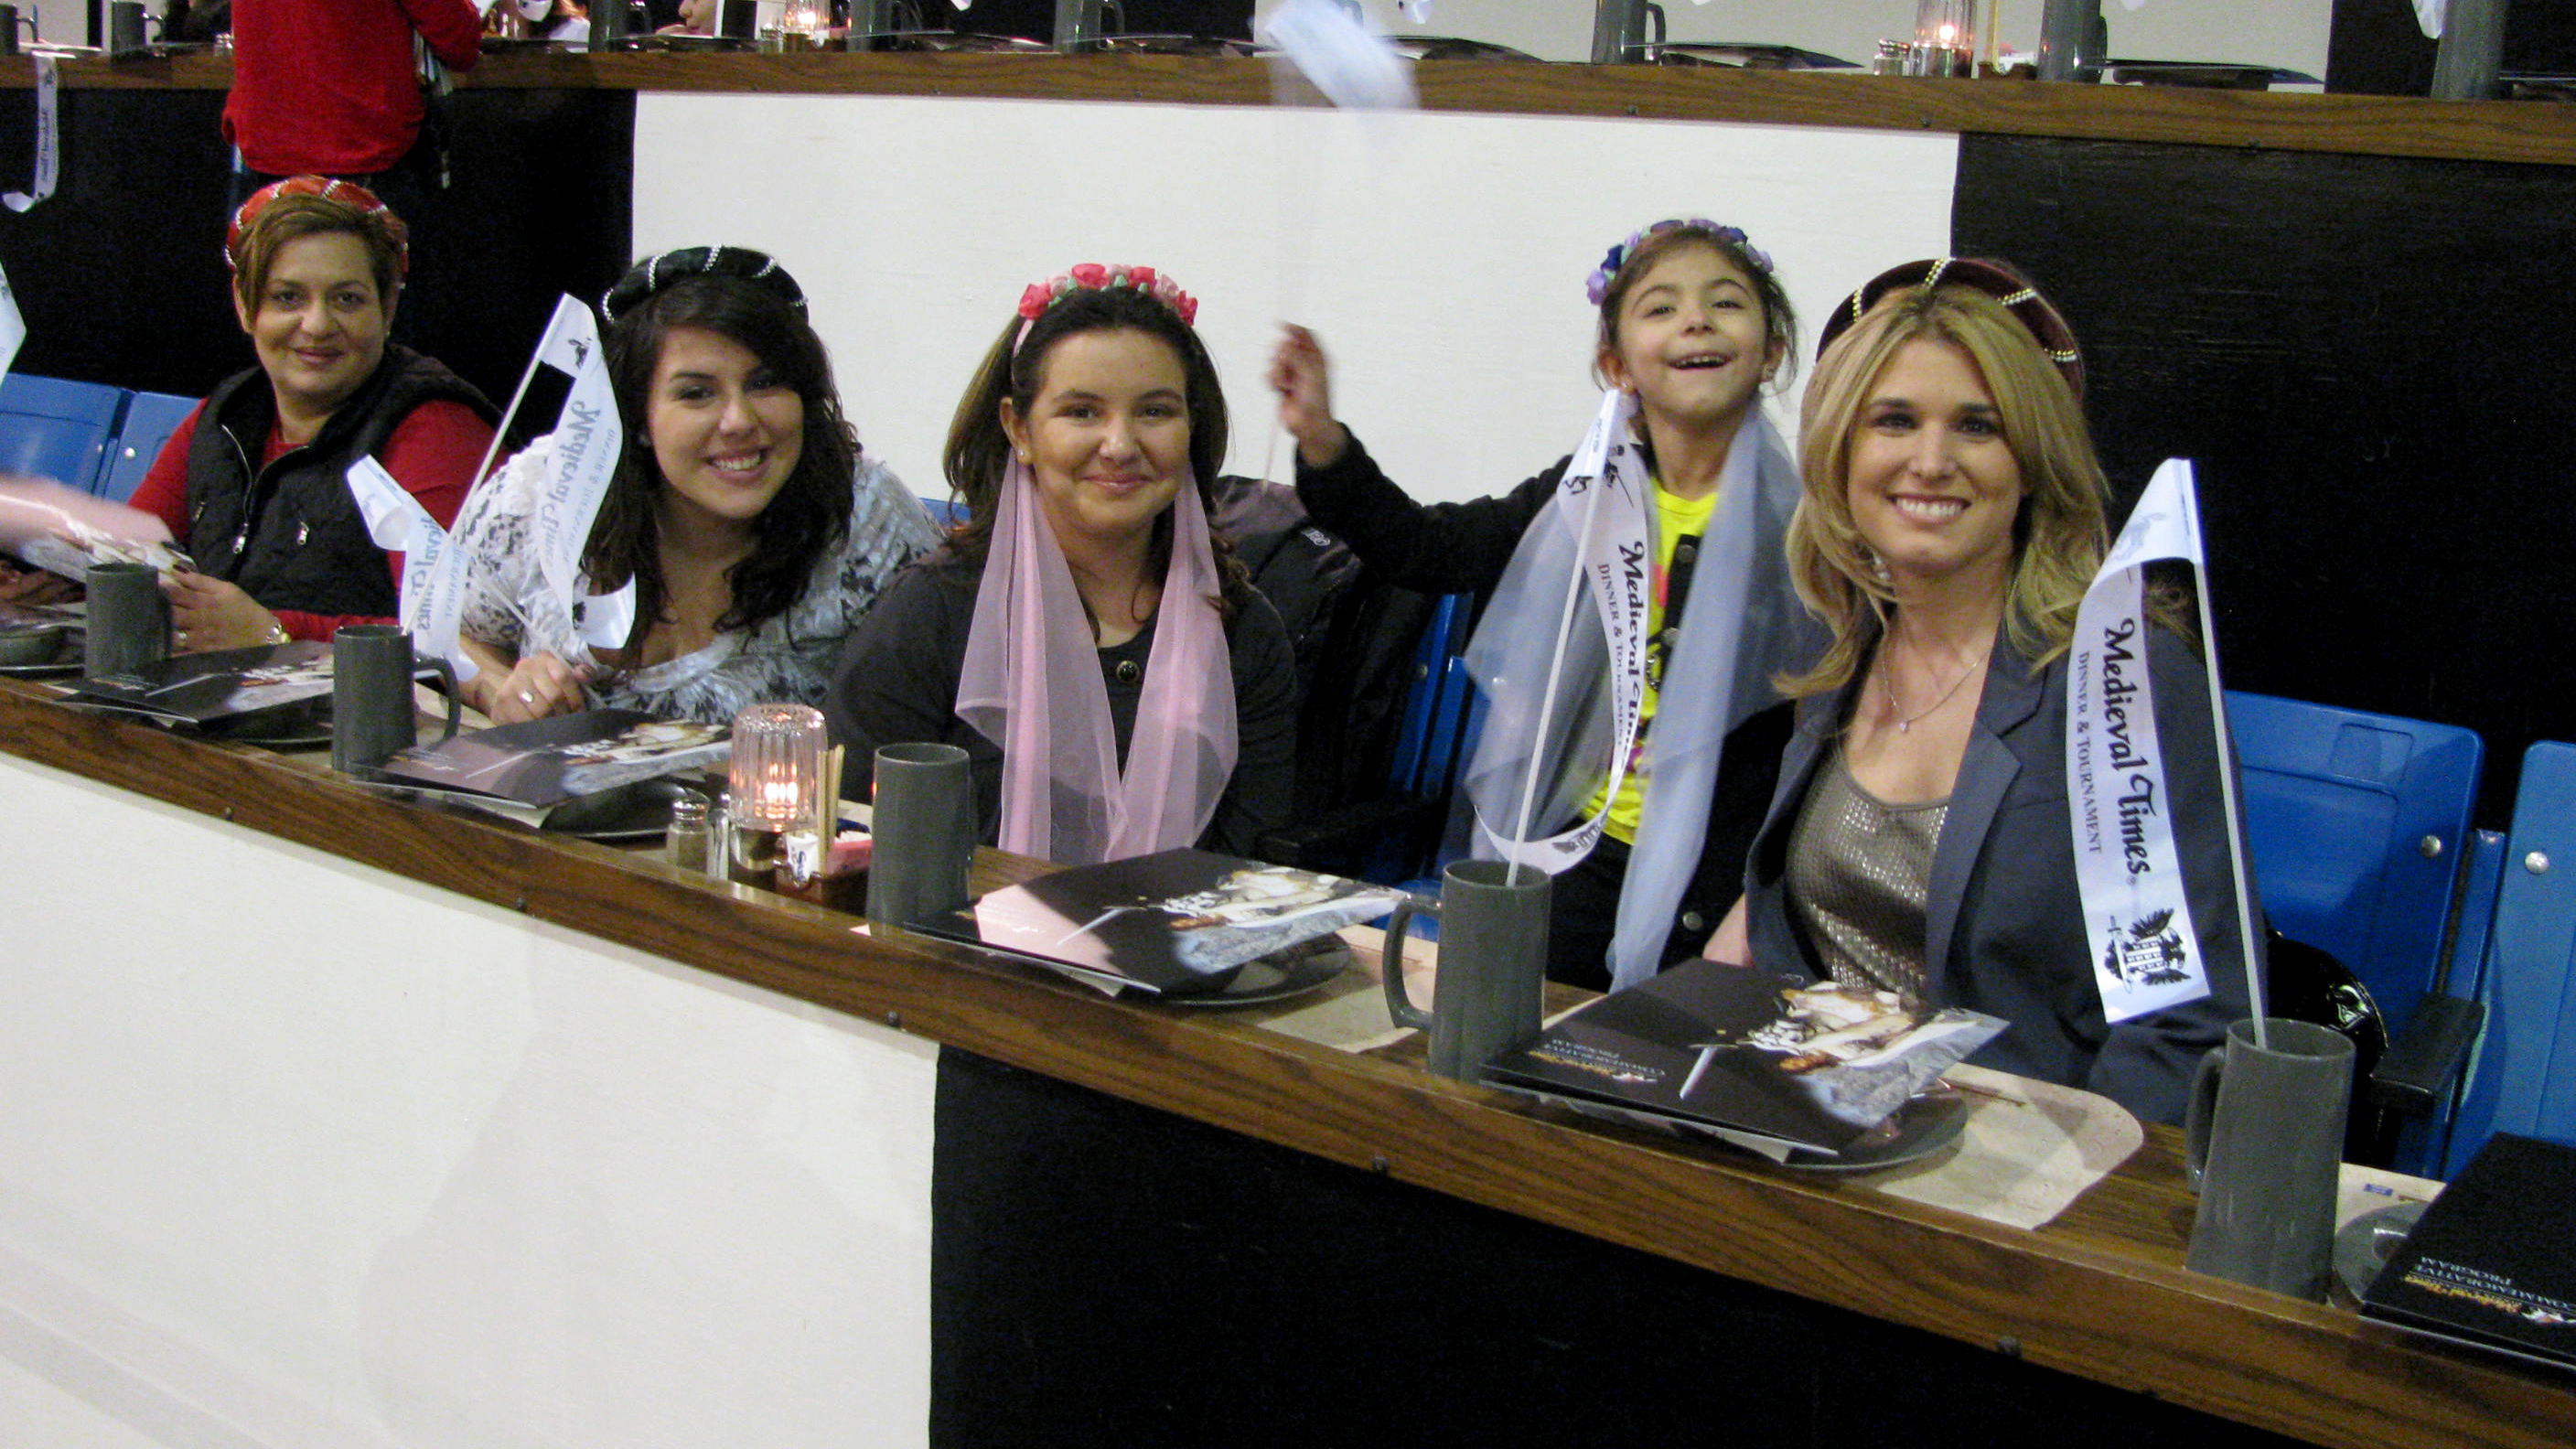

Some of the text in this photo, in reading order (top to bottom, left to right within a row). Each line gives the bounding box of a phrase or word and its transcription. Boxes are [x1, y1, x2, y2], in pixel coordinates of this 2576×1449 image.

[1598, 564, 1620, 621] DINNER
[1613, 627, 1623, 639] &
[1618, 541, 1646, 677] Medieval
[2077, 651, 2102, 853] DINNER & TOURNAMENT
[2103, 617, 2157, 875] Medieval Times
